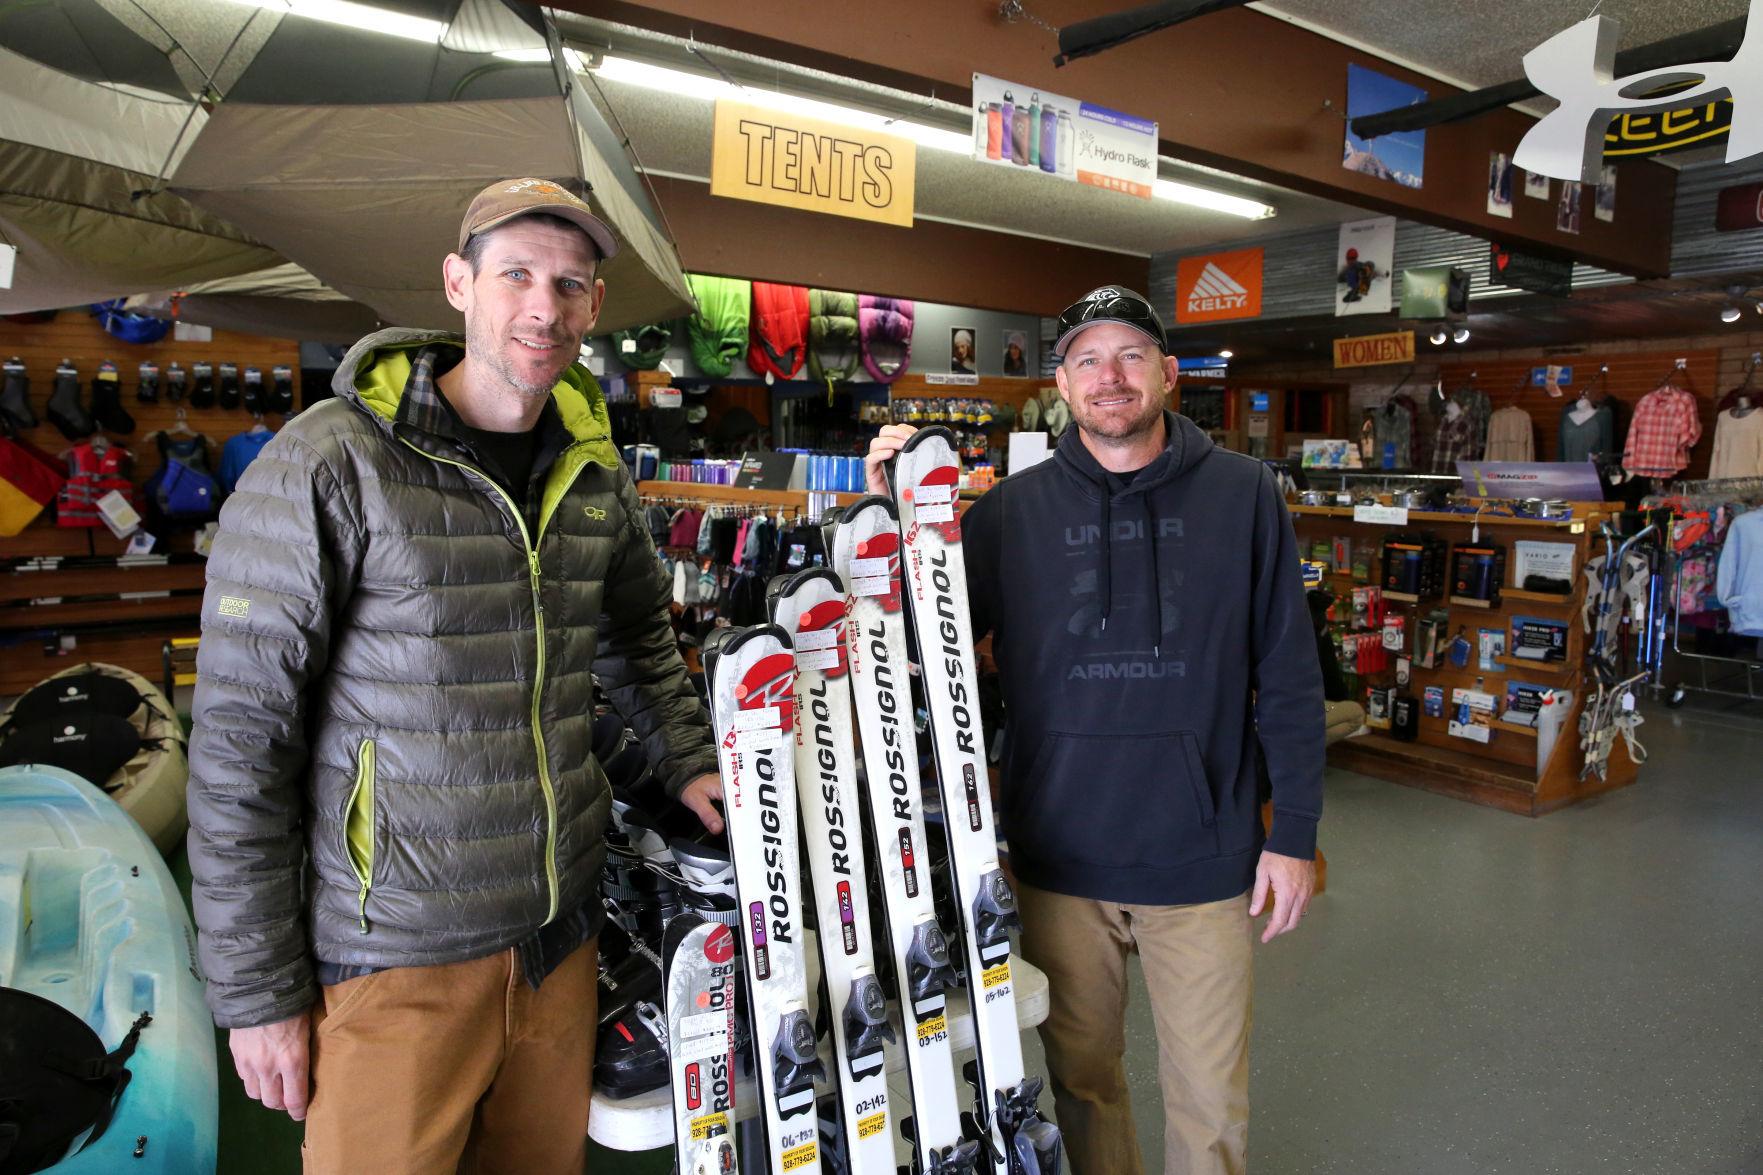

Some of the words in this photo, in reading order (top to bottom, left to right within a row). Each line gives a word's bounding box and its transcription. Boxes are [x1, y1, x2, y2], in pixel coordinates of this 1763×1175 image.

[739, 120, 893, 209] TENTS
[1094, 145, 1125, 162] Hydro
[1127, 154, 1151, 169] Flask
[1187, 294, 1247, 313] KELTY
[1339, 335, 1408, 366] WOMEN
[904, 521, 920, 546] 162
[1065, 518, 1184, 546] UNDR
[911, 549, 923, 601] FLASH
[848, 620, 860, 674] FLASH
[931, 549, 975, 754] ROSSIGNOL
[1067, 661, 1186, 680] ARMOUR
[792, 694, 804, 746] FLASH
[869, 620, 912, 821] ROSSIGNOL
[731, 752, 742, 808] FLASH
[810, 680, 850, 875] ROSSIGNOL
[966, 773, 974, 791] 162
[841, 891, 850, 912] 142
[754, 912, 762, 934] 132
[711, 963, 734, 978] 80
[725, 983, 734, 1010] PRO
[985, 986, 1011, 1004] 05-162
[710, 977, 730, 1113] ROSSOL
[919, 1031, 948, 1048] 03-152
[856, 1094, 887, 1115] 02-142
[781, 1128, 815, 1148] 06-132
